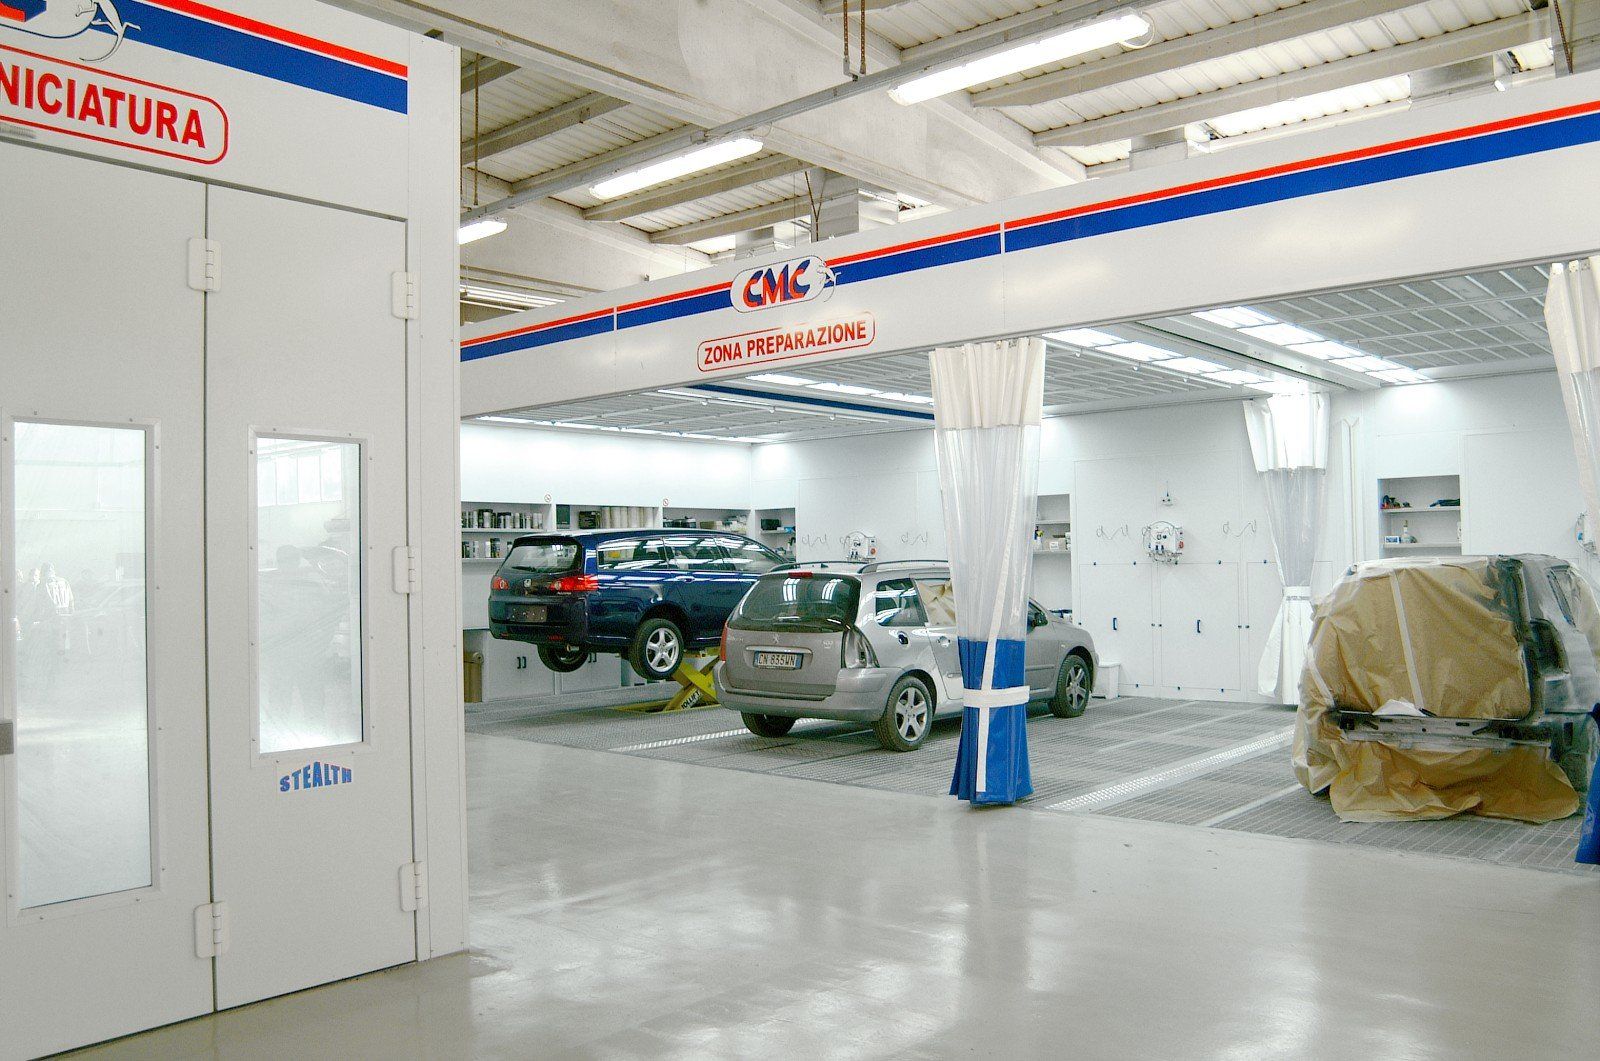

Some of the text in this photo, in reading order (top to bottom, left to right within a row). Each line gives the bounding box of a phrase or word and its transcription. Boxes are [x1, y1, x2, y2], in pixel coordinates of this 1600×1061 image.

[743, 259, 811, 308] CMC
[704, 319, 867, 365] ZONA PREPARAZIONE
[279, 761, 352, 792] STEALTH
